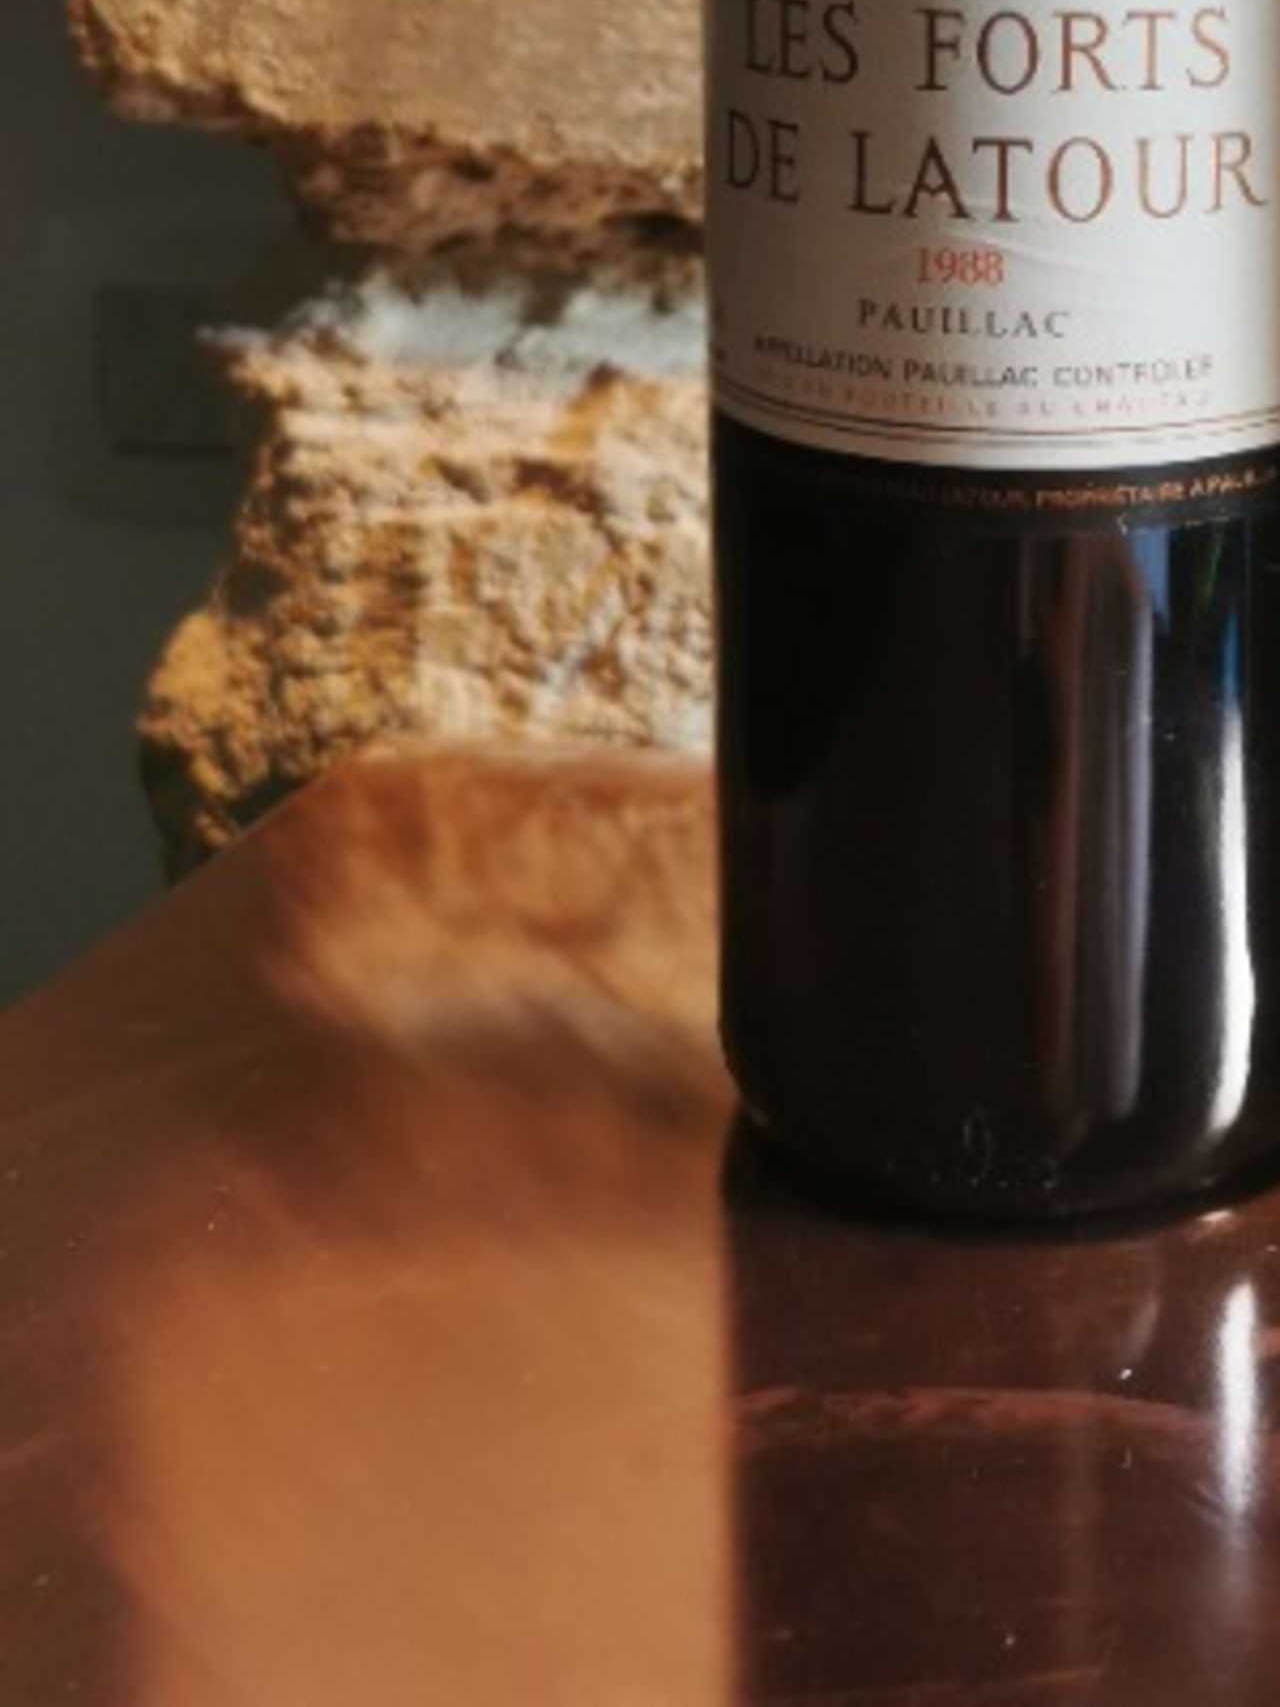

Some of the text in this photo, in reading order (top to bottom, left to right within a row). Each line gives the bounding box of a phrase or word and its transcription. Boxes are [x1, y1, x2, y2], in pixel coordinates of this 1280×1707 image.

[915, 5, 1231, 95] FORTS
[725, 108, 1270, 223] DE LATOUR
[915, 245, 1005, 286] 1988
[857, 298, 1072, 339] PAUILLAC
[755, 335, 892, 382] APPELLATION
[904, 358, 1039, 388] PAUILLAC
